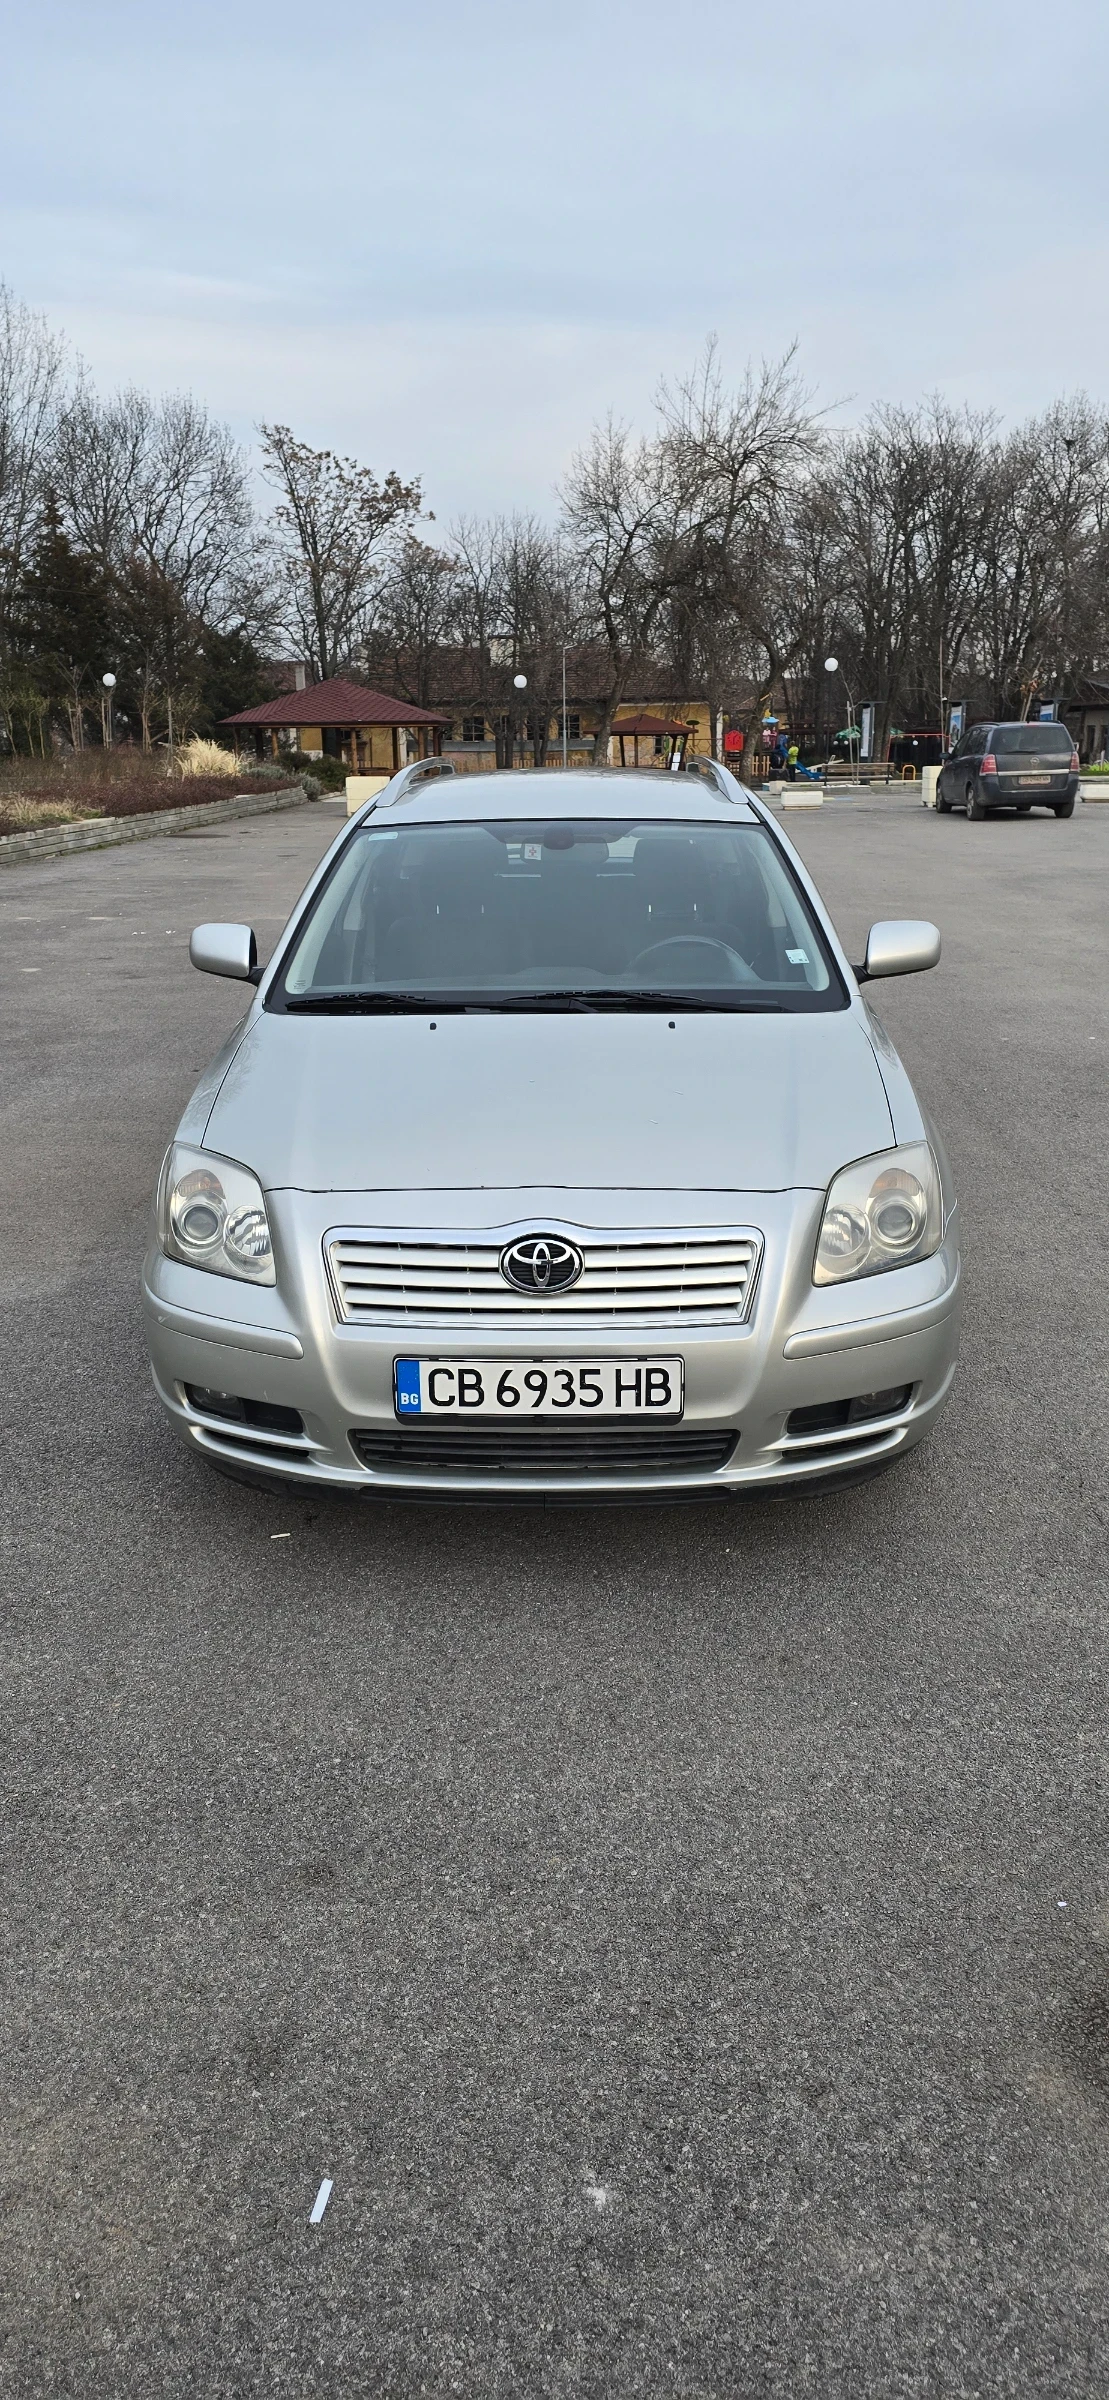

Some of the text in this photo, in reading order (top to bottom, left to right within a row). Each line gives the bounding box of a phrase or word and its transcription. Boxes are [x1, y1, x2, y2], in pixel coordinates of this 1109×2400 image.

[400, 1392, 419, 1405] BG
[428, 1367, 672, 1408] CB 6935 HB
